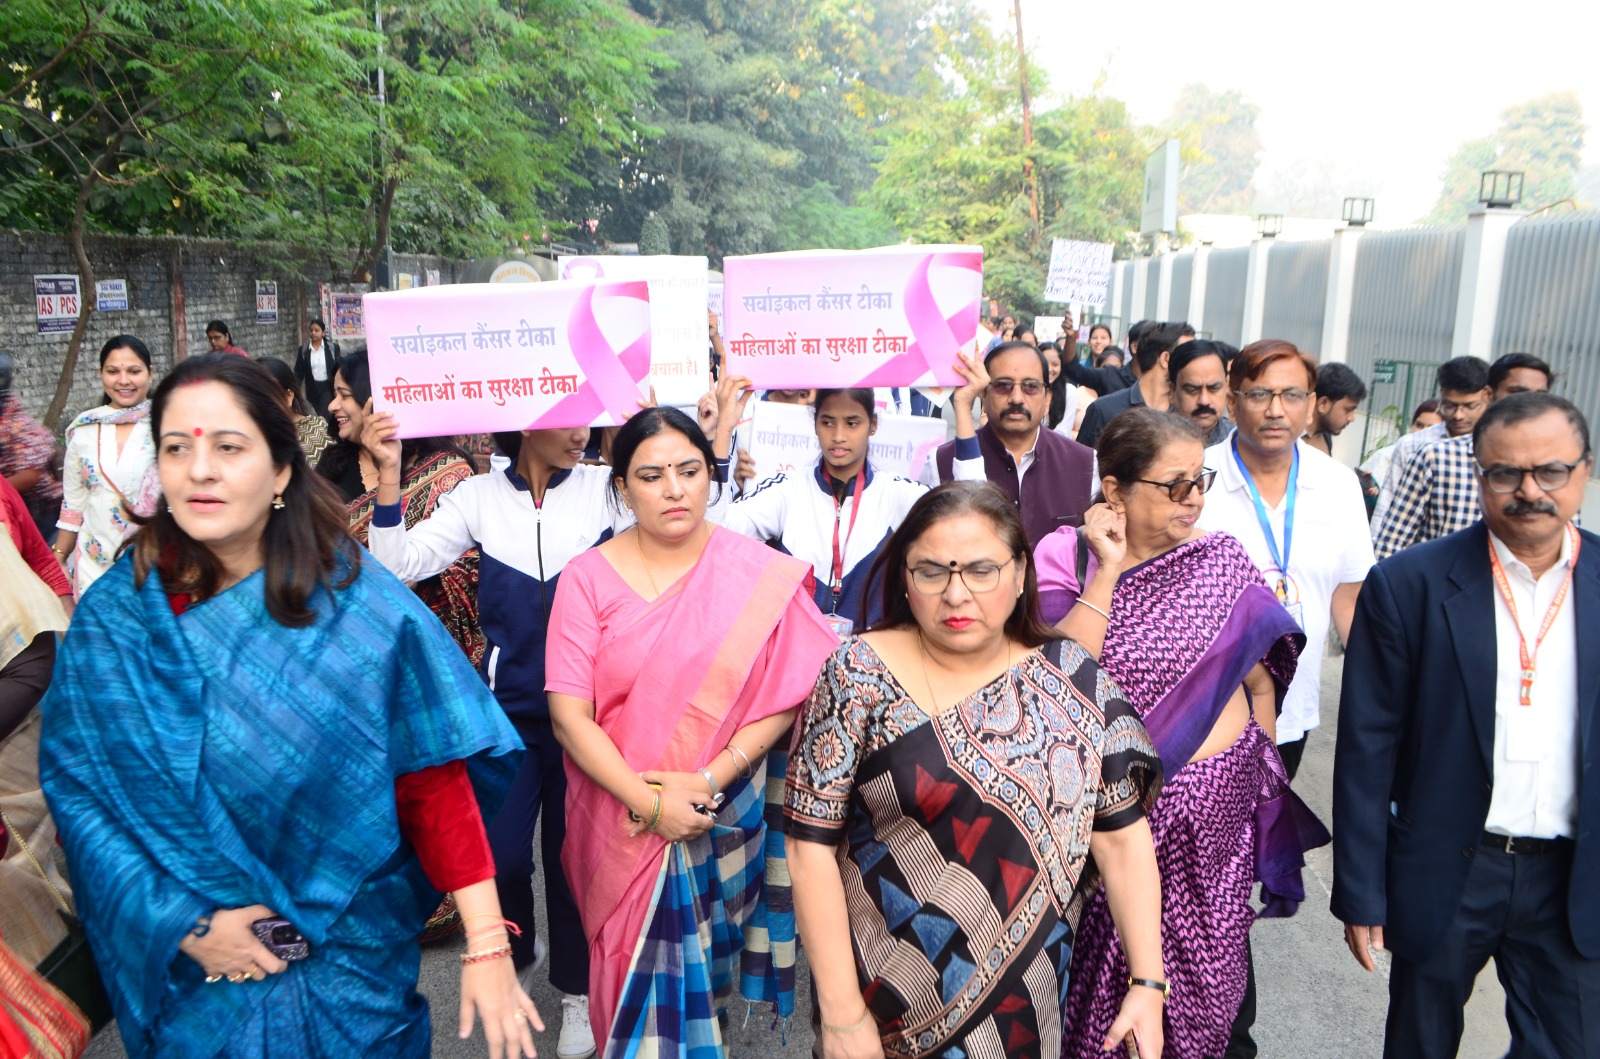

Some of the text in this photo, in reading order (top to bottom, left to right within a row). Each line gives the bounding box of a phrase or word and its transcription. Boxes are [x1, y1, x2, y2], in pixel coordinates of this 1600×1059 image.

[60, 296, 77, 314] PCS
[743, 284, 893, 315] सर्वाइकल कैंसर टीका
[391, 318, 556, 356] सर्वाइकल कैंसर टीका
[730, 328, 907, 362] महिलाओं का सुरक्षा टीका
[382, 366, 578, 406] महिलाओं का सुरक्षा टीका
[756, 424, 811, 450] सर्वाइकल
